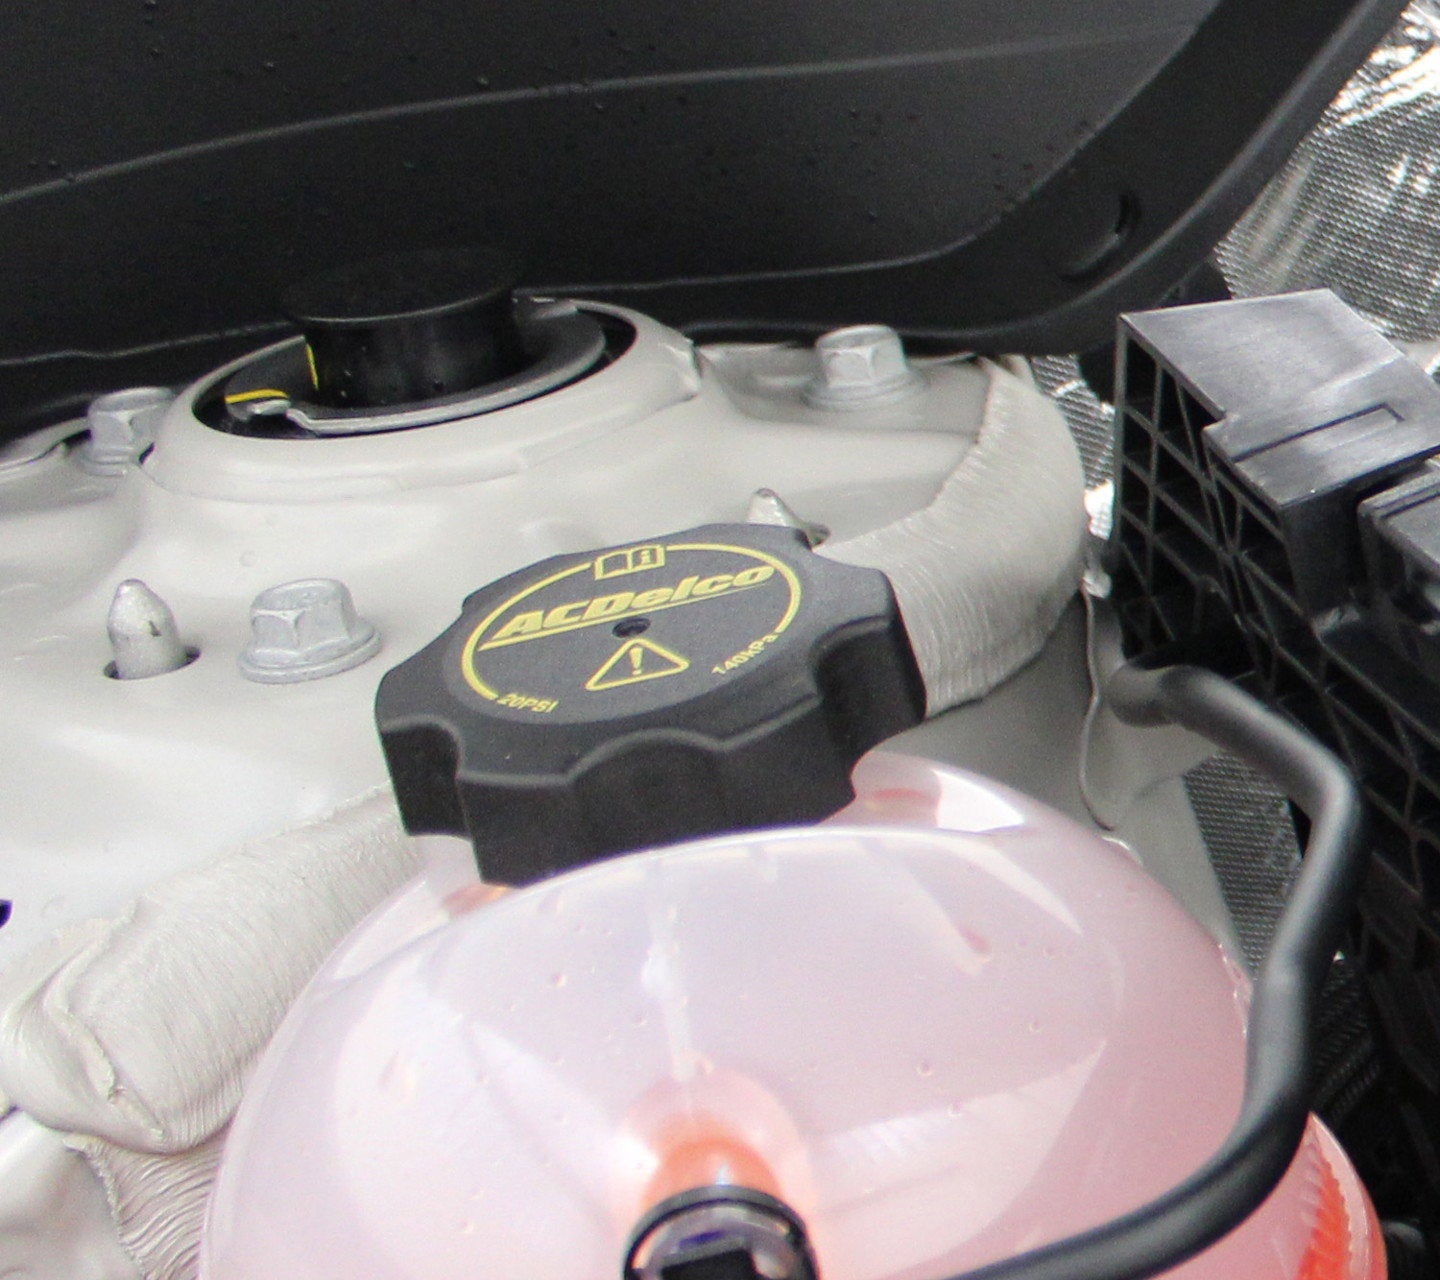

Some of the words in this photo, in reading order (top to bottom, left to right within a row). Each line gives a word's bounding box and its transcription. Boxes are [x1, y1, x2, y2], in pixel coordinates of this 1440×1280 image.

[490, 566, 776, 638] ACDelco
[711, 632, 780, 677] 140kPa
[496, 692, 558, 714] 20PSI
